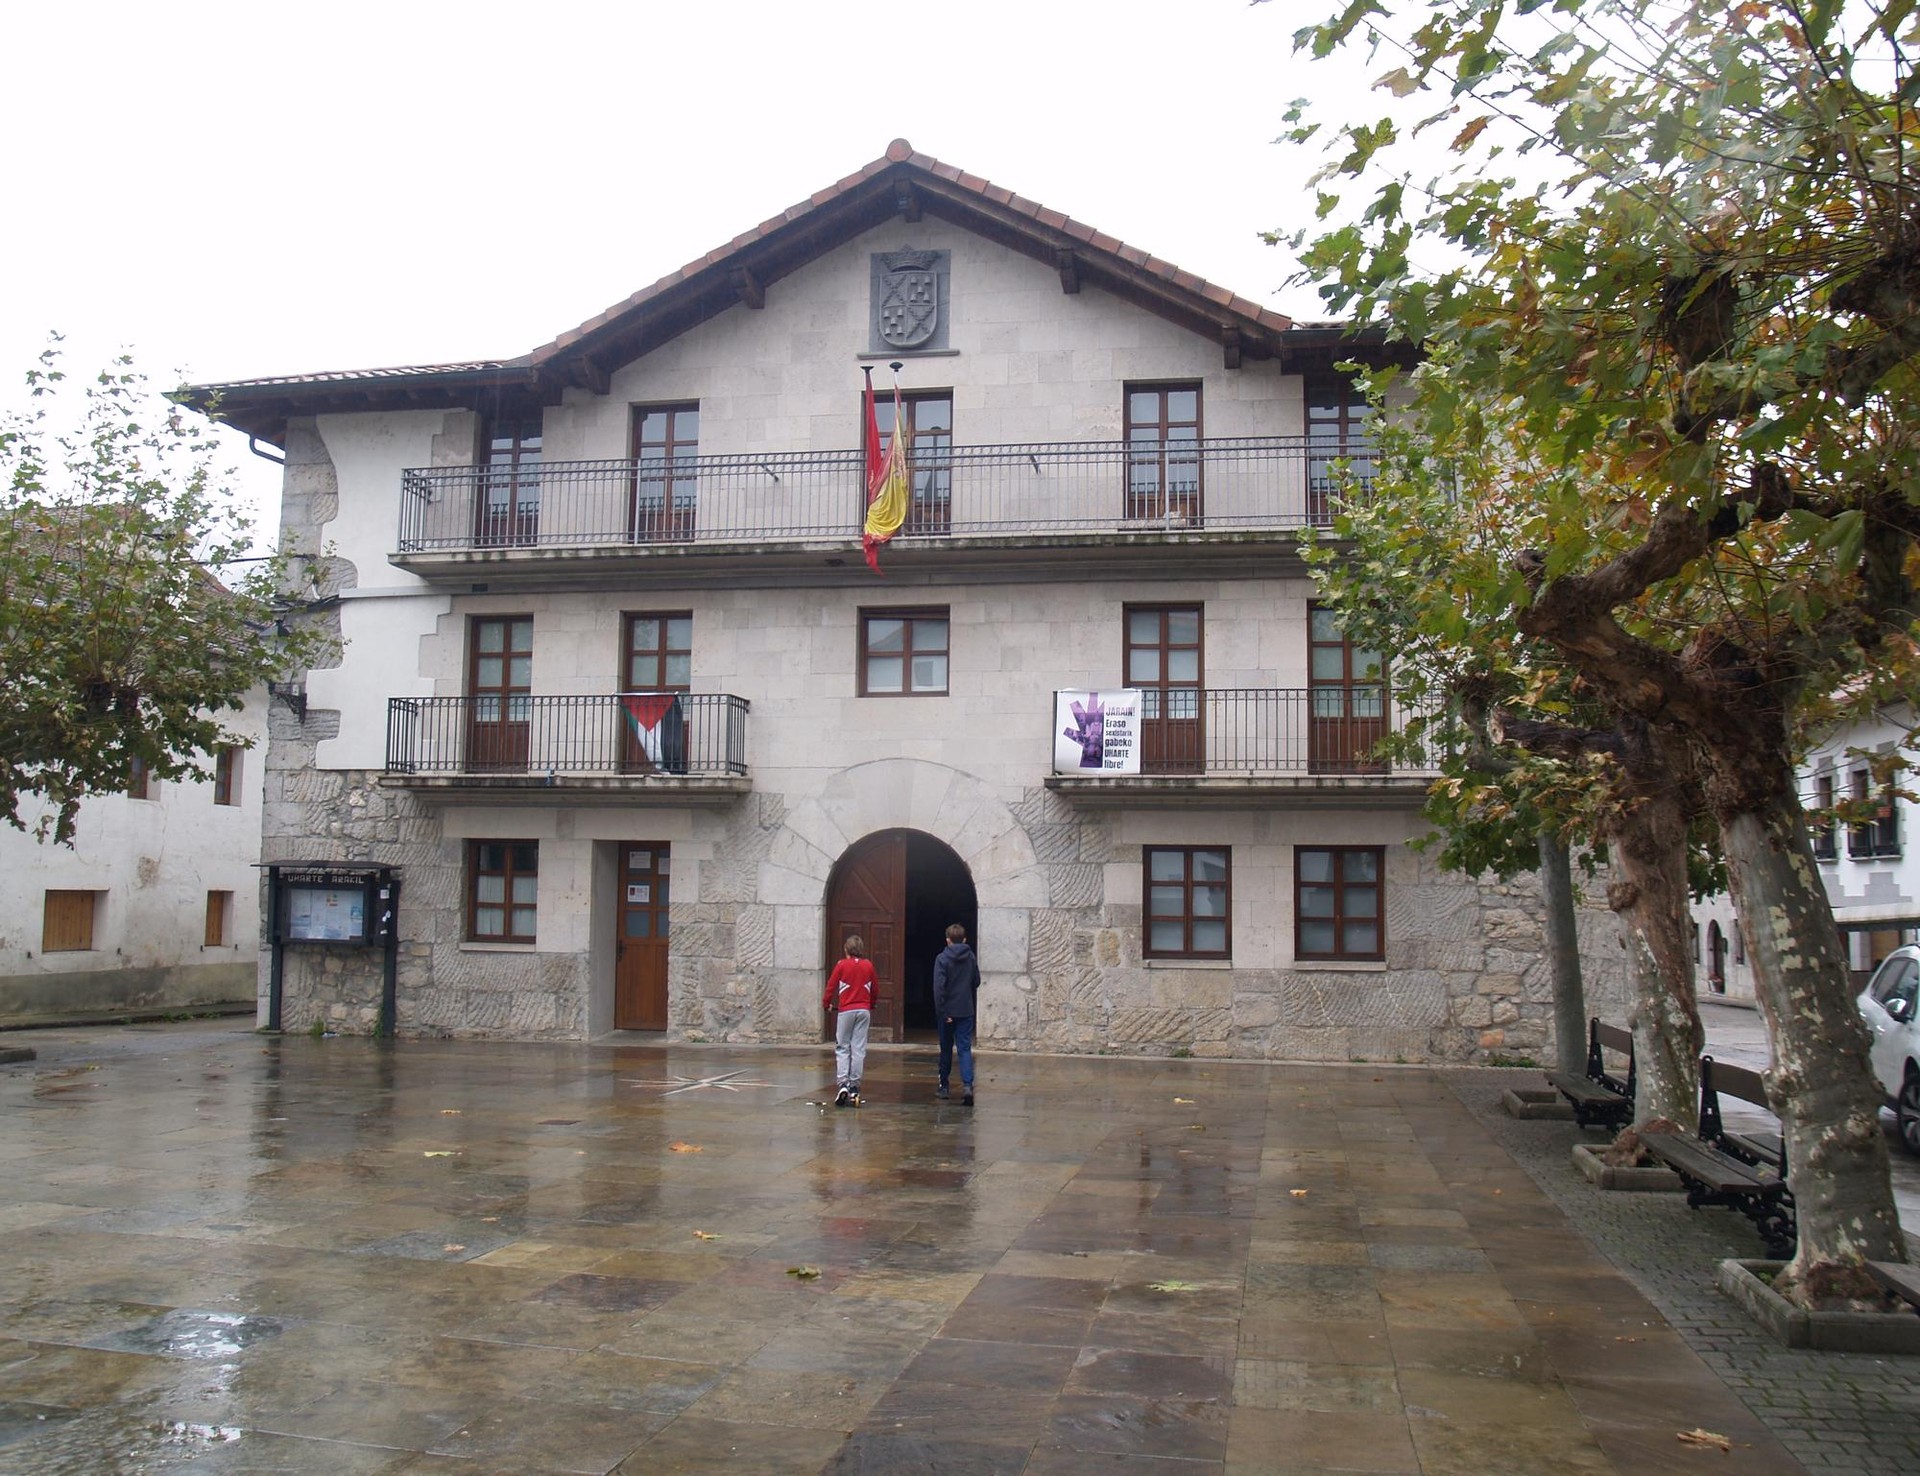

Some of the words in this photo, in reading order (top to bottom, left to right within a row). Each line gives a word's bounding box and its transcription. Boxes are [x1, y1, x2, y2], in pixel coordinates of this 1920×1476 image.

[1106, 719, 1126, 728] Eraso
[1105, 738, 1132, 747] gabeko
[1105, 749, 1129, 758] UHARTE
[1105, 760, 1124, 769] libre!
[288, 875, 323, 883] UHARTE
[331, 876, 365, 884] ARAKIL
